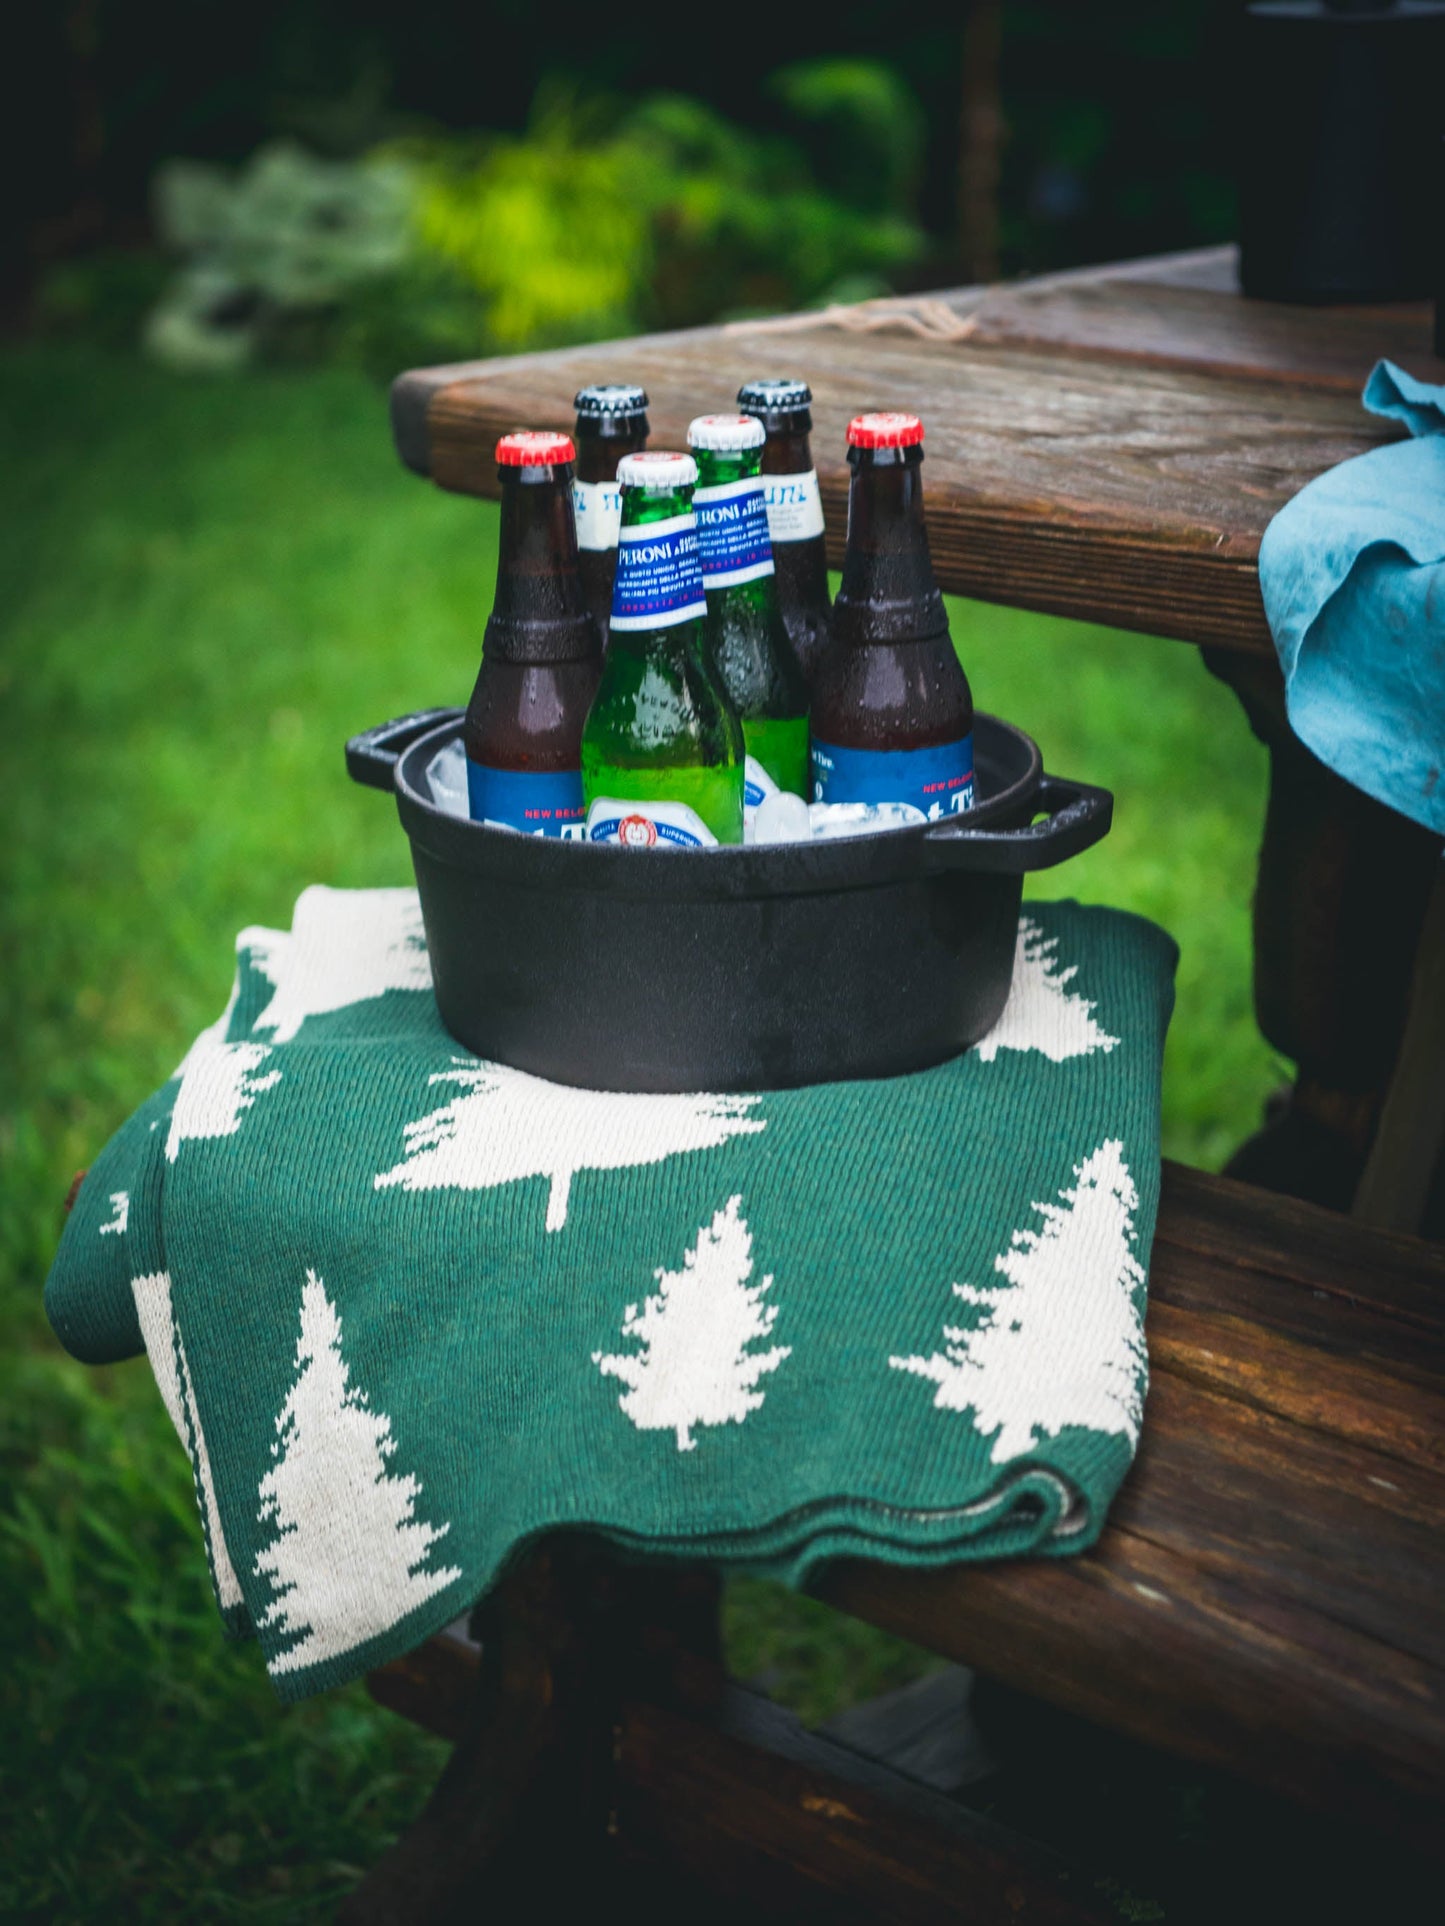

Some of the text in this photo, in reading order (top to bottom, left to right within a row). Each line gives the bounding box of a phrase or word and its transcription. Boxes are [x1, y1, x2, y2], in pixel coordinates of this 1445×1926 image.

[695, 503, 740, 526] ERONI
[619, 542, 672, 566] PERONI
[923, 782, 946, 793] NEW
[525, 808, 552, 819] NEW
